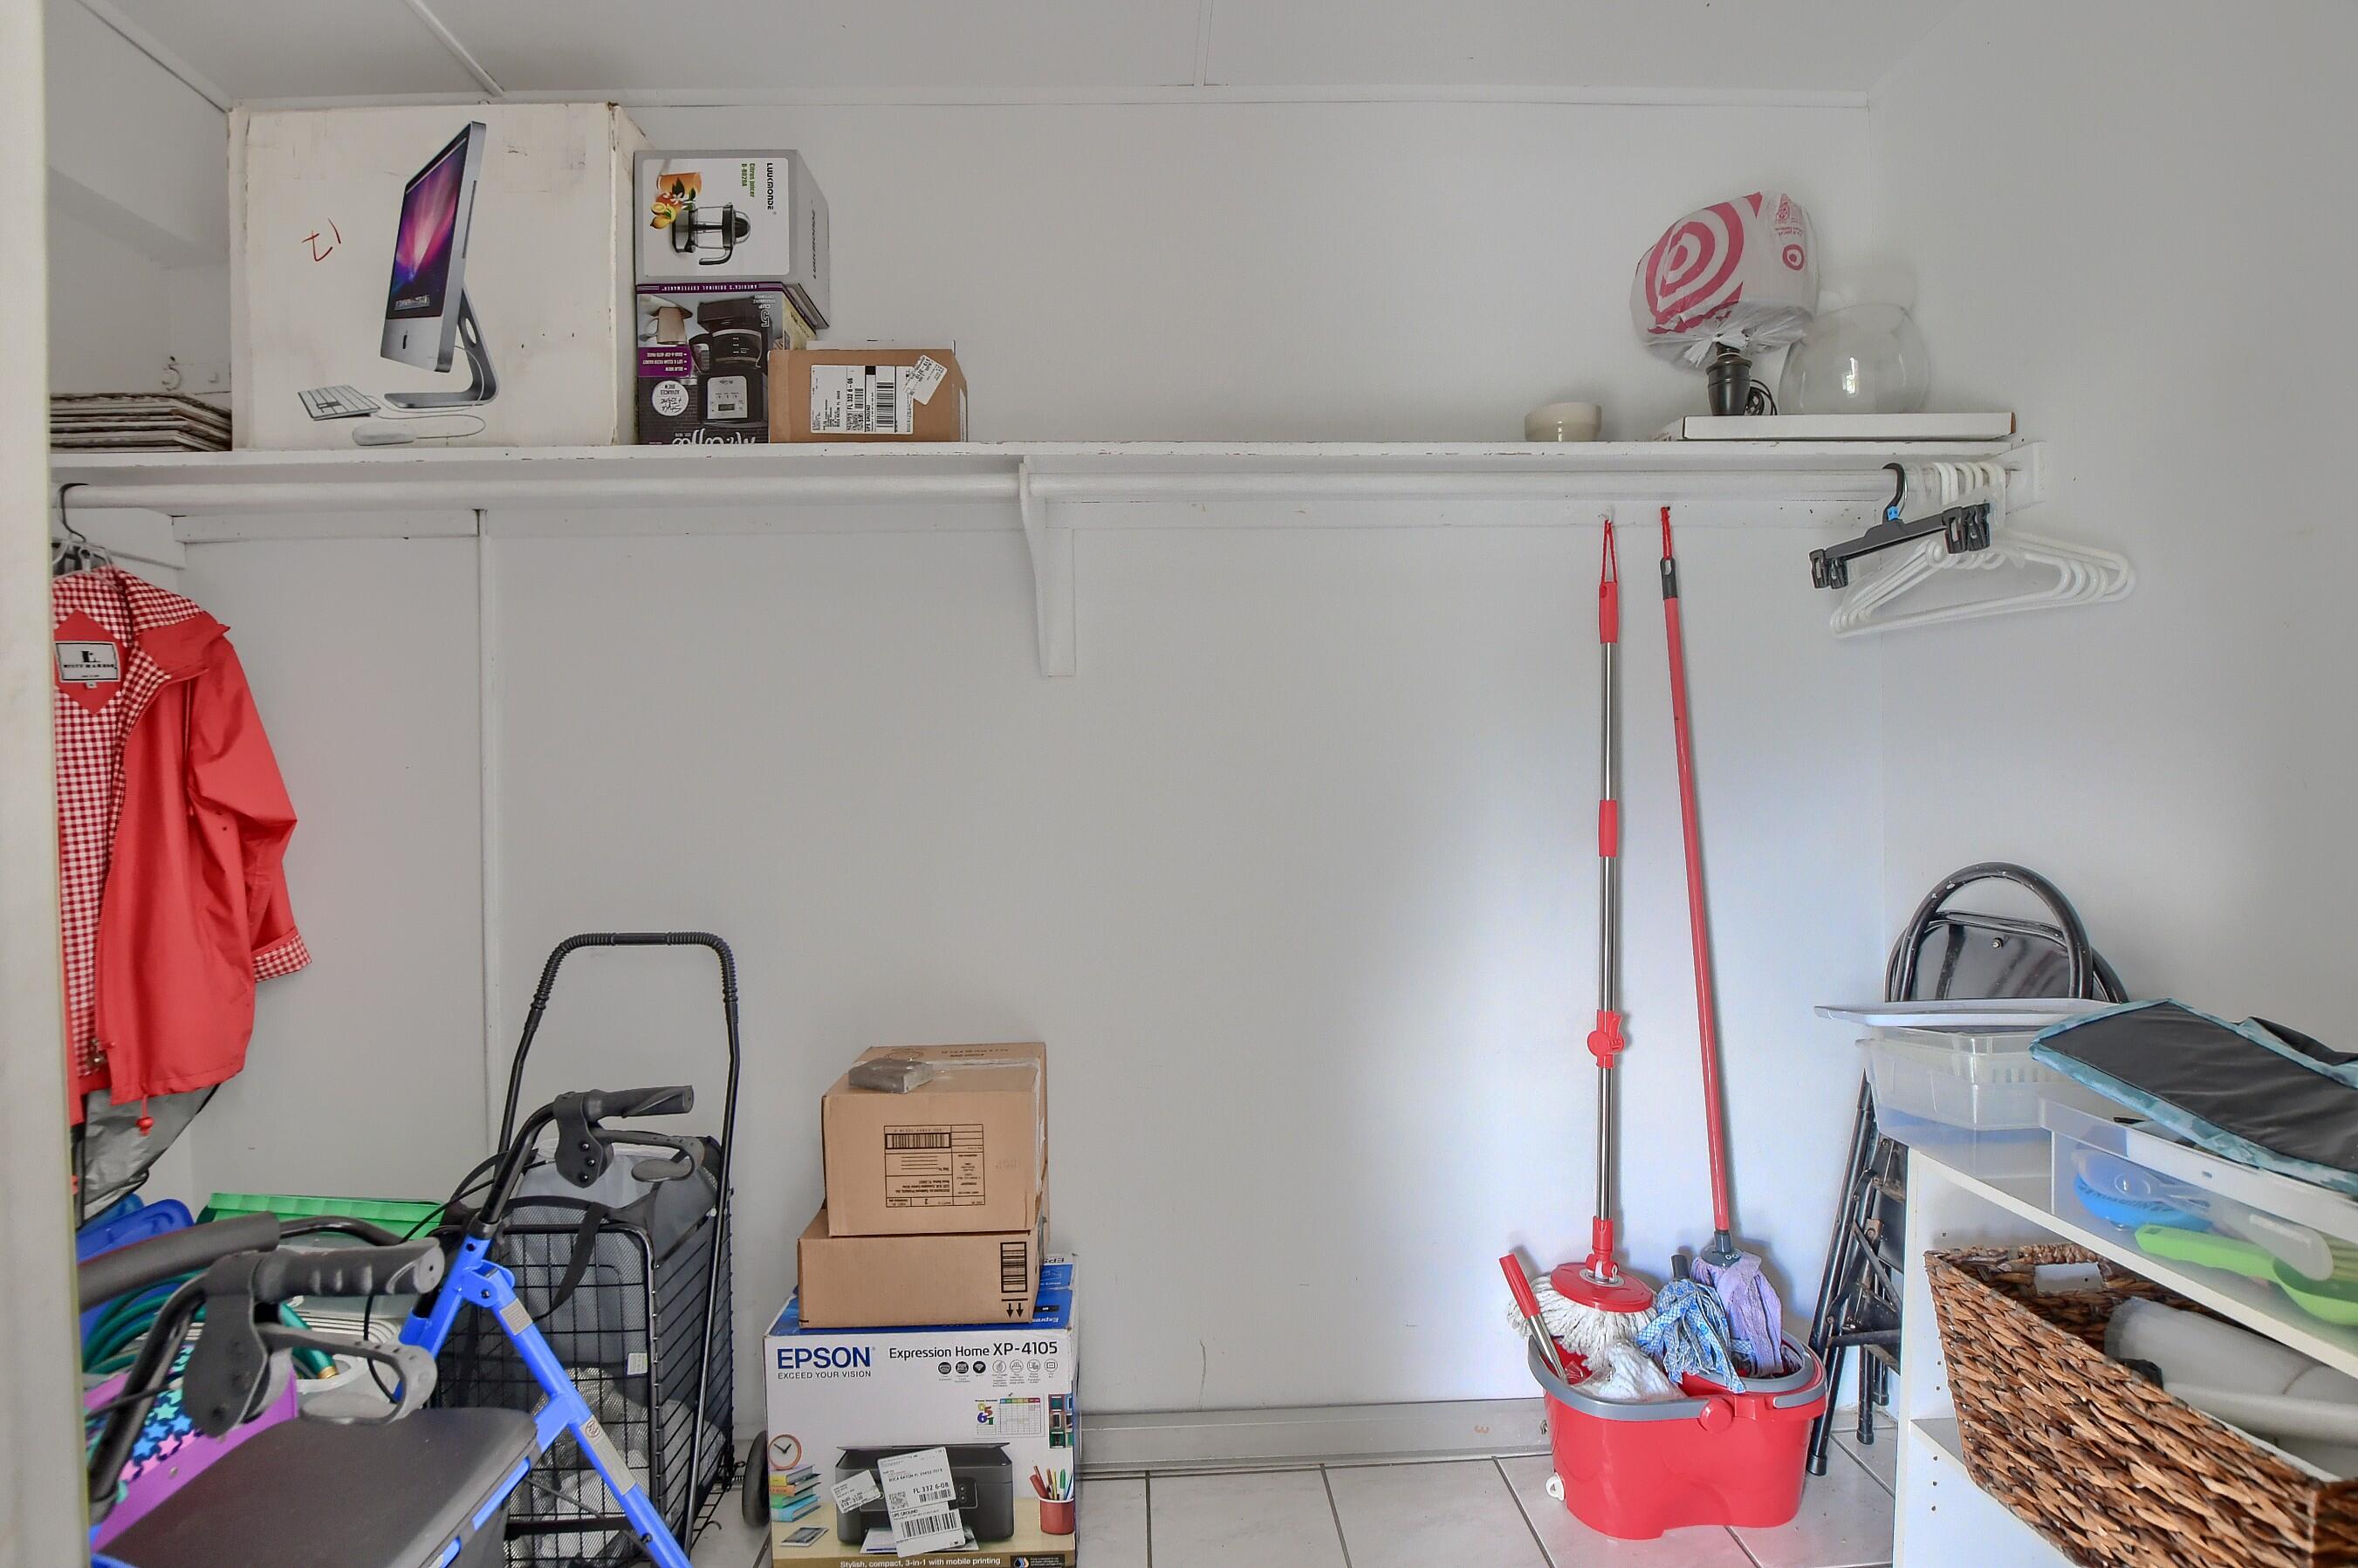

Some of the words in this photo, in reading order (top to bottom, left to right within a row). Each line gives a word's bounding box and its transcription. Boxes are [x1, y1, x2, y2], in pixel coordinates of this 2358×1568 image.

[760, 309, 770, 328] 5
[889, 1346, 952, 1361] Expression
[955, 1345, 990, 1358] Home
[992, 1341, 1059, 1356] XP-4105
[777, 1346, 872, 1370] EPSON
[841, 1370, 871, 1379] VISION
[977, 1412, 988, 1423] 6
[922, 1484, 934, 1493] 332
[972, 1557, 1001, 1566] printing
